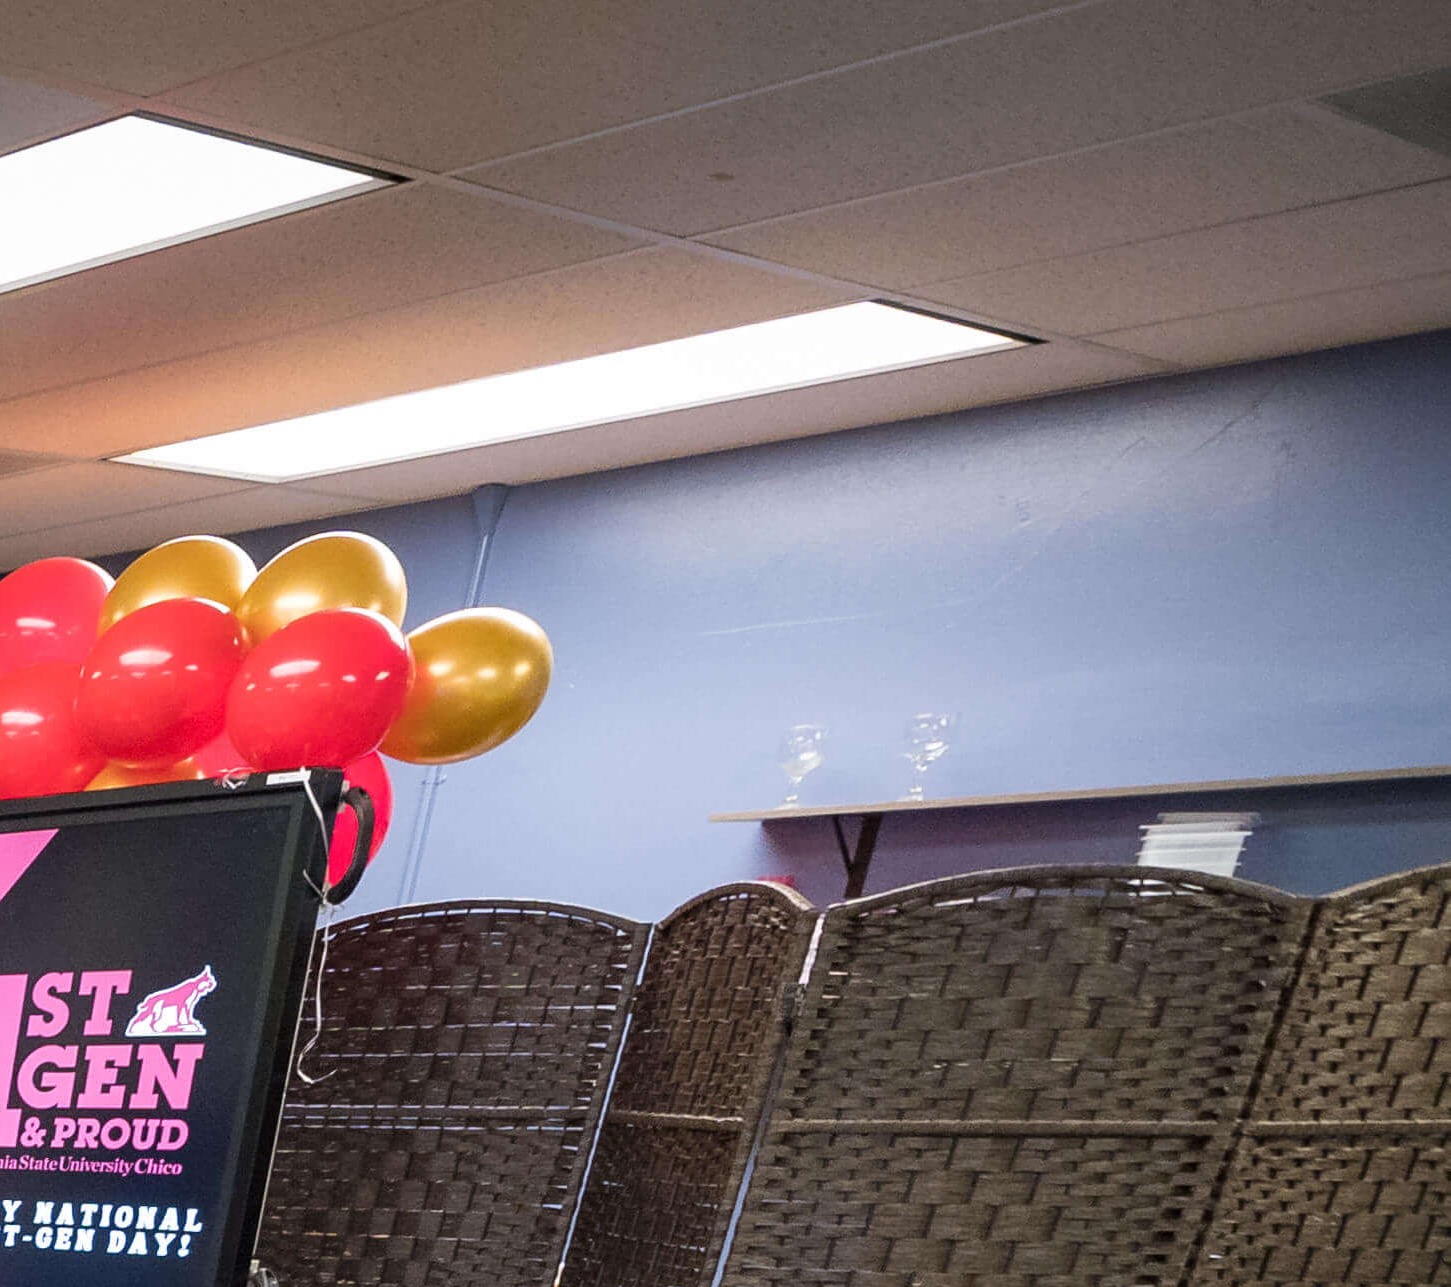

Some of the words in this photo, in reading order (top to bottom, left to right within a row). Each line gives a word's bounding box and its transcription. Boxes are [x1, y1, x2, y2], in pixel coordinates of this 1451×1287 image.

[17, 1044, 205, 1110] GEN
[20, 1117, 47, 1148] &
[50, 1118, 190, 1151] PROUD
[18, 1155, 58, 1171] State
[59, 1156, 135, 1177] University
[134, 1158, 183, 1176] Chico
[33, 1201, 204, 1233] NATIONAL
[106, 1229, 192, 1257] DAY!
